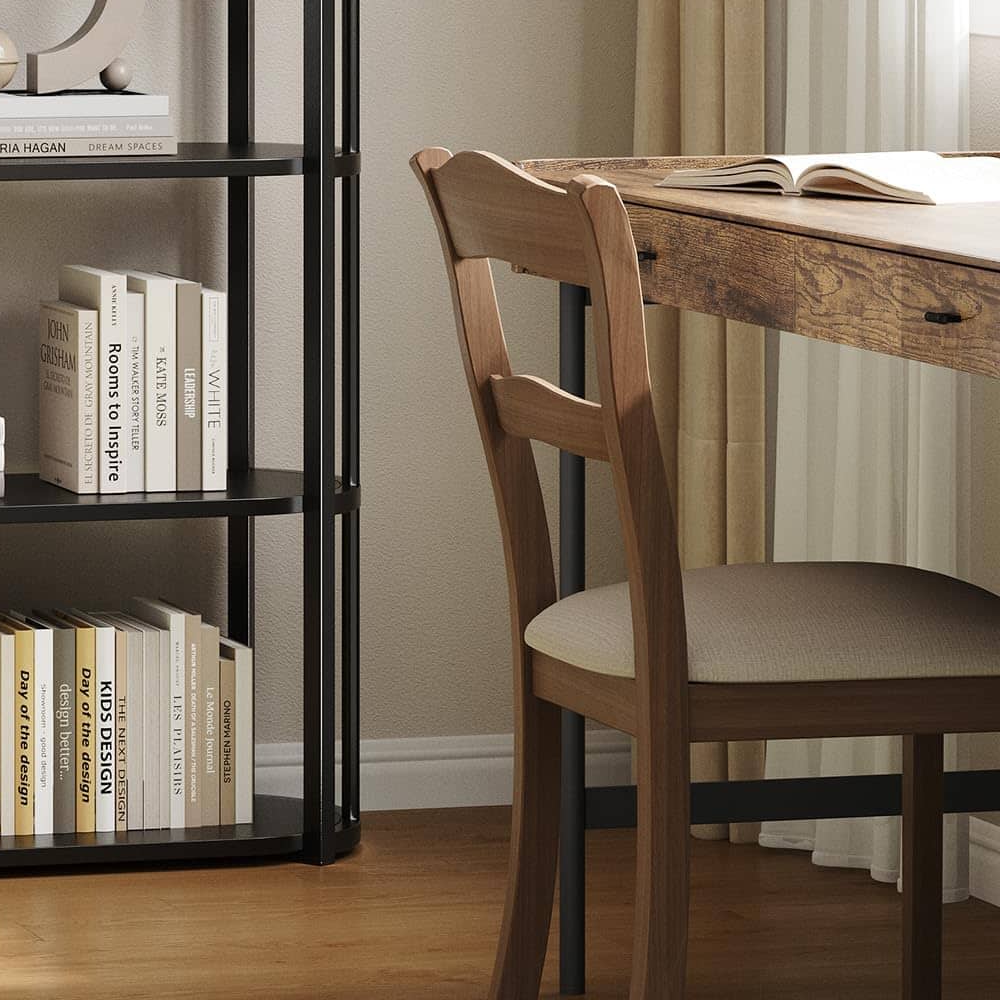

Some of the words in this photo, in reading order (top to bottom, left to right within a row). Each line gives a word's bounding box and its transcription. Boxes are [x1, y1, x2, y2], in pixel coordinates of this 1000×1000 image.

[24, 142, 66, 153] HAGAN
[88, 143, 123, 152] DREAM
[128, 142, 163, 151] SPACES
[47, 318, 69, 342] JOHN
[40, 344, 76, 372] GRISHAM
[84, 321, 93, 382] MOUNTAIN
[108, 344, 122, 398] Rooms
[156, 357, 167, 390] KATE
[84, 384, 93, 409] GRAY
[156, 392, 167, 427] MOSS
[184, 368, 196, 418] LEADERSHIP
[208, 369, 221, 429] WHITE
[84, 414, 93, 426] DE
[108, 404, 120, 420] to
[84, 429, 93, 471] SECRETO
[105, 426, 122, 482] Inspire
[18, 670, 30, 700] Day
[80, 667, 92, 698] Day
[206, 688, 215, 700] Le
[20, 704, 30, 720] of
[56, 683, 72, 728] design
[82, 703, 92, 719] of
[100, 680, 112, 722] KIDS
[118, 696, 126, 723] THE
[173, 696, 182, 721] LES
[82, 723, 92, 748] the
[206, 701, 215, 737] Monde
[20, 725, 30, 749] the
[118, 727, 126, 765] NEXT
[100, 727, 112, 794] DESIGN
[173, 728, 182, 796] PLAISIRS
[206, 738, 215, 774] Journal
[18, 754, 30, 806] design
[80, 752, 92, 803] design
[118, 770, 126, 822] DESIGN
